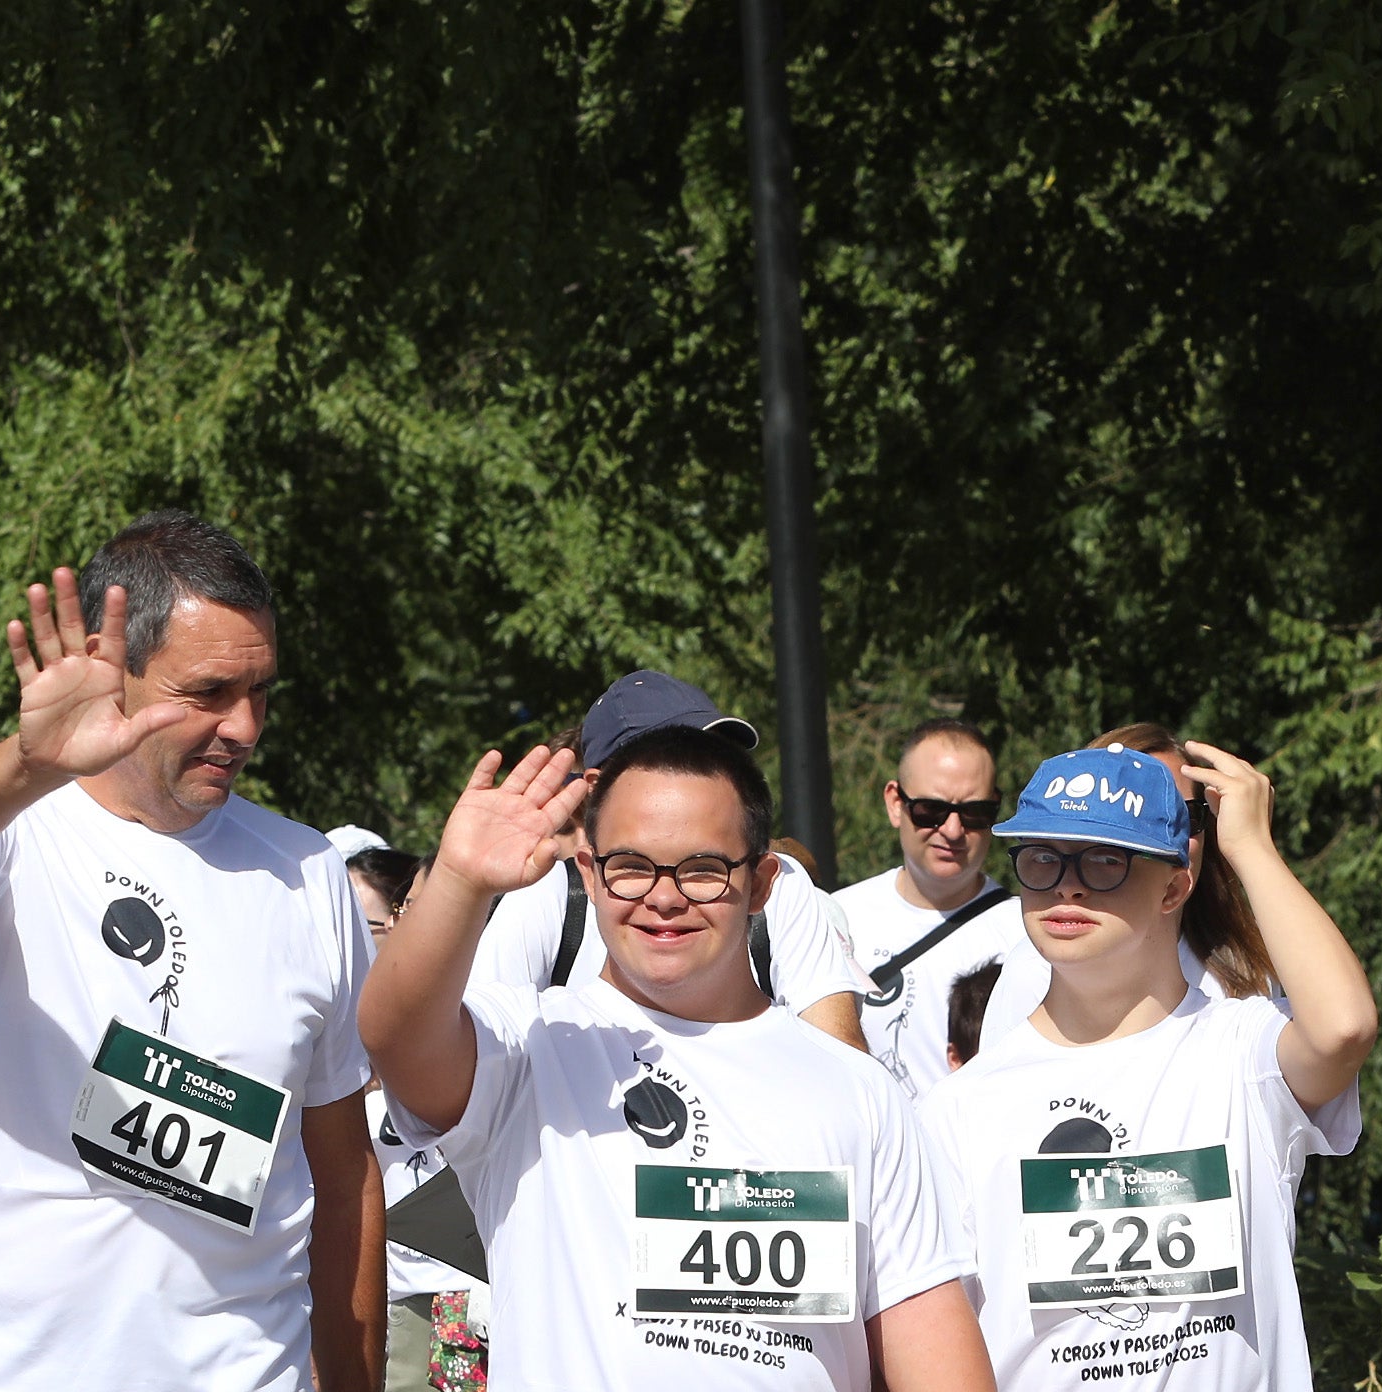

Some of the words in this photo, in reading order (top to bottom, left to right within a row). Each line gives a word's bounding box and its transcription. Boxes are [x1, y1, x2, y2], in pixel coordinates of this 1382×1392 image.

[1044, 773, 1144, 817] DOWN
[1060, 800, 1089, 811] Toledo
[105, 871, 164, 907] DOWN
[164, 911, 187, 987] TOLEDO
[180, 1083, 234, 1112] Diputación
[184, 1070, 237, 1102] TOLEDO
[1049, 1097, 1111, 1122] DOWN
[110, 1100, 226, 1185] 401
[688, 1095, 710, 1163] TOLED
[111, 1160, 203, 1203] www.diputoledo.es
[1119, 1169, 1178, 1185] TOLEDO
[1119, 1183, 1179, 1196] Diputación
[734, 1199, 795, 1209] Diputación
[735, 1186, 795, 1199] TOLEDO
[1068, 1213, 1195, 1275] 226
[680, 1230, 806, 1288] 400
[615, 1302, 627, 1317] X
[645, 1331, 689, 1350] DOWN
[694, 1338, 749, 1361] TOLEDO
[1051, 1348, 1061, 1363] X
[1062, 1341, 1106, 1363] CROSS
[1110, 1340, 1120, 1355] Y
[1124, 1334, 1167, 1355] PASEO
[1081, 1364, 1124, 1381] DOWN
